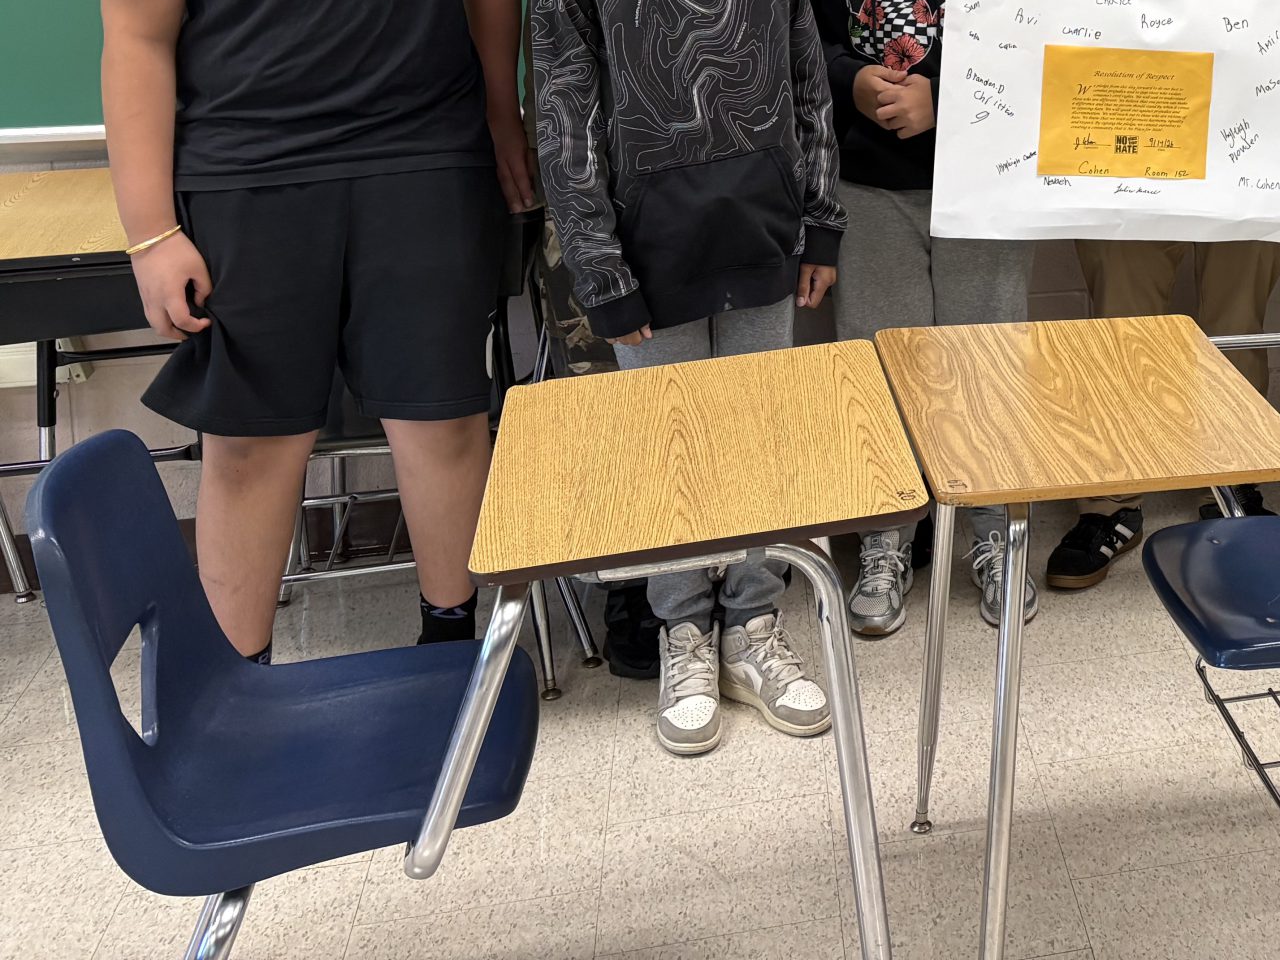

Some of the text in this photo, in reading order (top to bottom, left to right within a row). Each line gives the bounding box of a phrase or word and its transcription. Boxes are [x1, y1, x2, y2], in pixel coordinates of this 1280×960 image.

[1140, 13, 1174, 30] Royce
[1222, 16, 1249, 33] Ben
[1094, 70, 1176, 82] Resolution of Respect
[1116, 136, 1128, 145] NO
[1115, 145, 1138, 154] HATE
[1078, 160, 1110, 175] Cohen
[1144, 166, 1190, 178] Room 152
